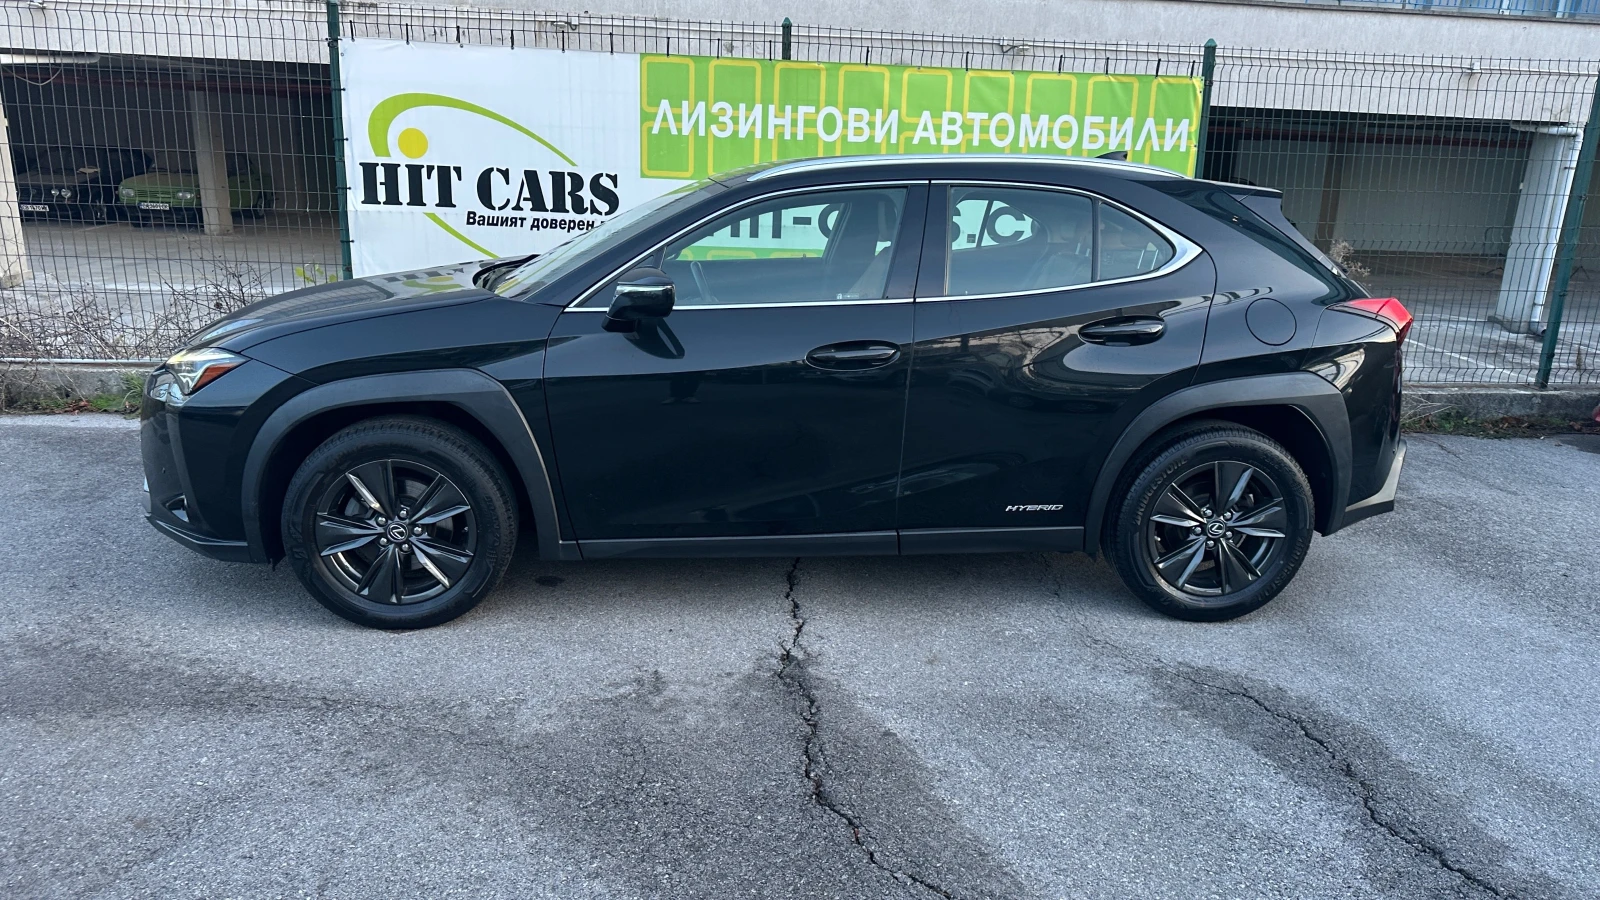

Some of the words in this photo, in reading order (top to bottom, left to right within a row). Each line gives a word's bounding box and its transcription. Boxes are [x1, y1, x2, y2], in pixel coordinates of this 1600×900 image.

[652, 99, 899, 144] ЛИЗИНГОВИ
[912, 111, 1190, 152] АВТОМОБИЛИ
[359, 162, 461, 207] HIT
[477, 167, 620, 216] CARS
[466, 211, 527, 229] Вашият
[530, 217, 595, 233] доверен
[1005, 504, 1064, 512] HYBRID
